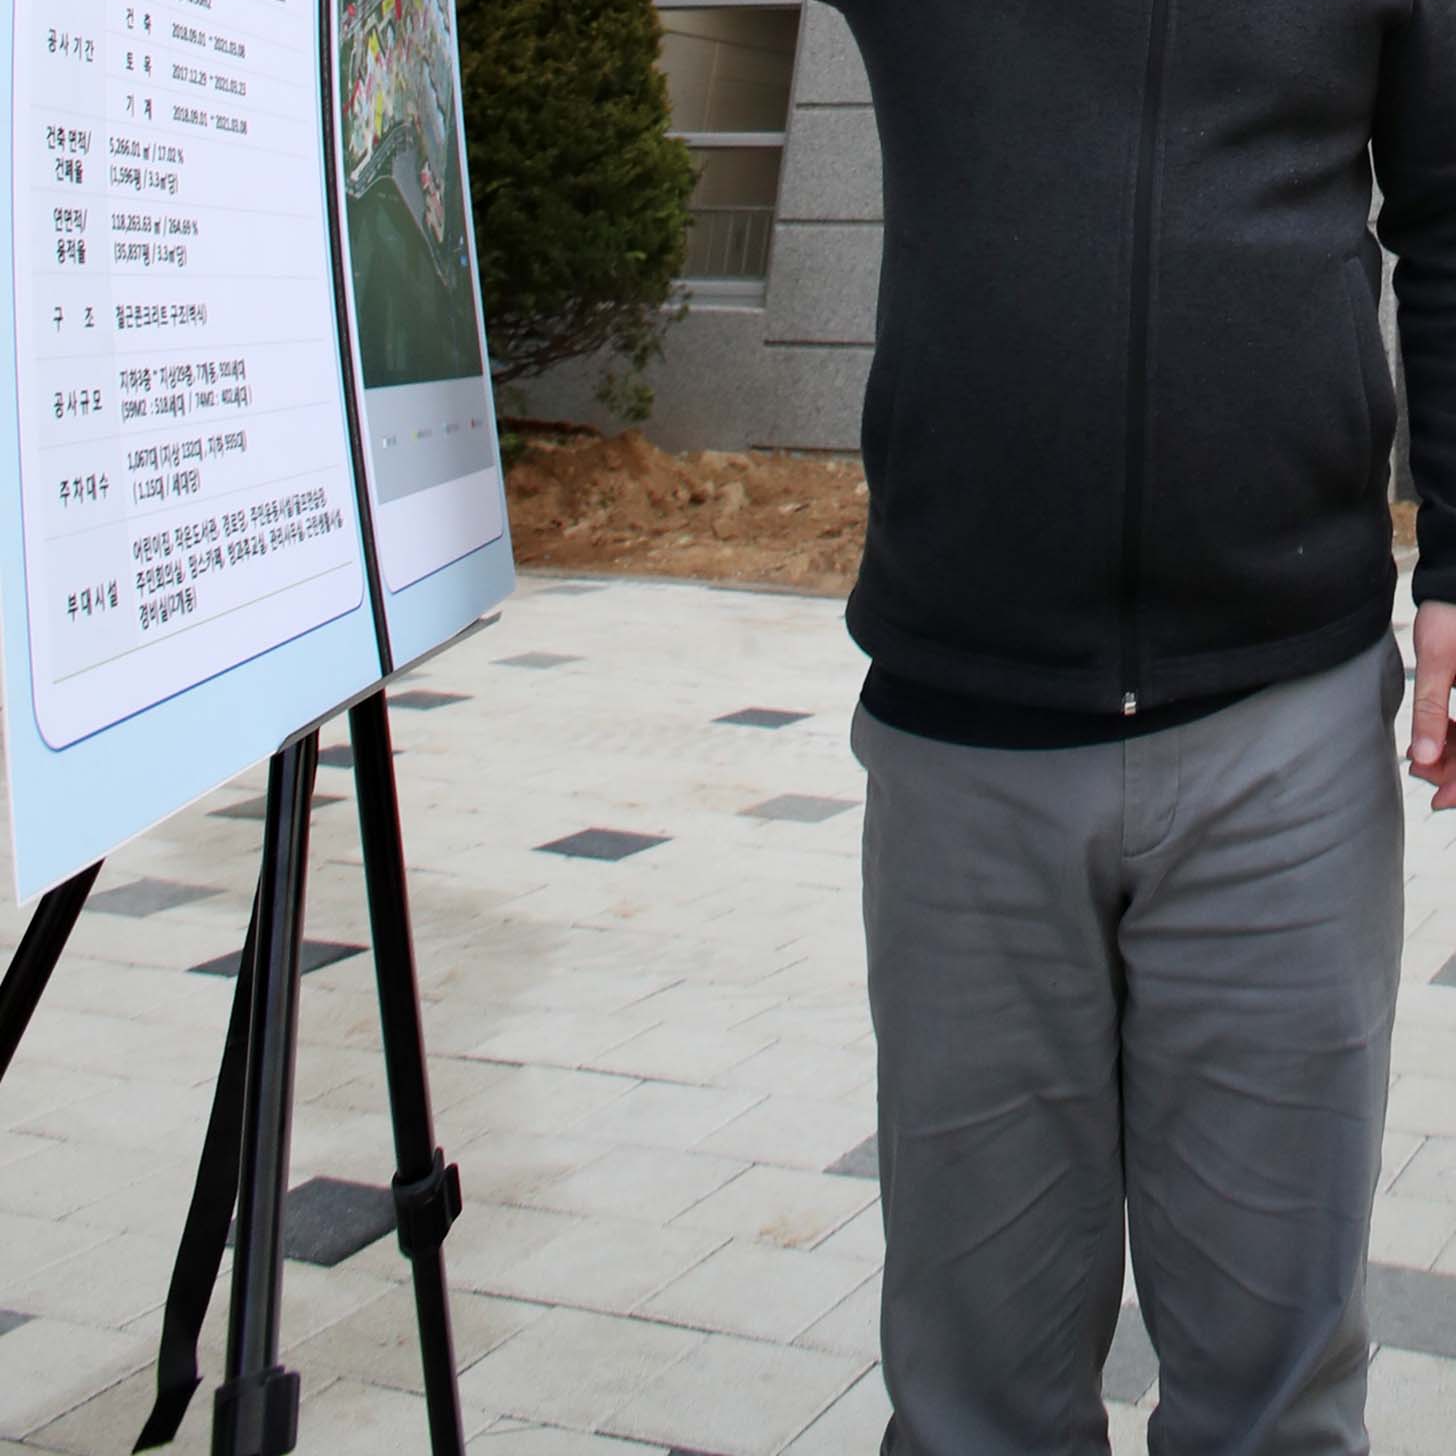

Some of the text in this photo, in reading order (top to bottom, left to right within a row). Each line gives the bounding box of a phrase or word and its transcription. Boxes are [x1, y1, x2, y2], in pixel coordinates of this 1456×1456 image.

[109, 136, 142, 159] 5,266.01
[157, 144, 177, 164] 17.02
[115, 304, 169, 331] 철근콘크리트
[119, 367, 152, 394] 지하3층
[127, 445, 159, 473] 1,067대
[132, 530, 174, 565] 어린이집,
[174, 517, 221, 552] 작은도서관,
[135, 559, 186, 598] 주민회의실,
[138, 585, 198, 631] 경비실(2개동)
